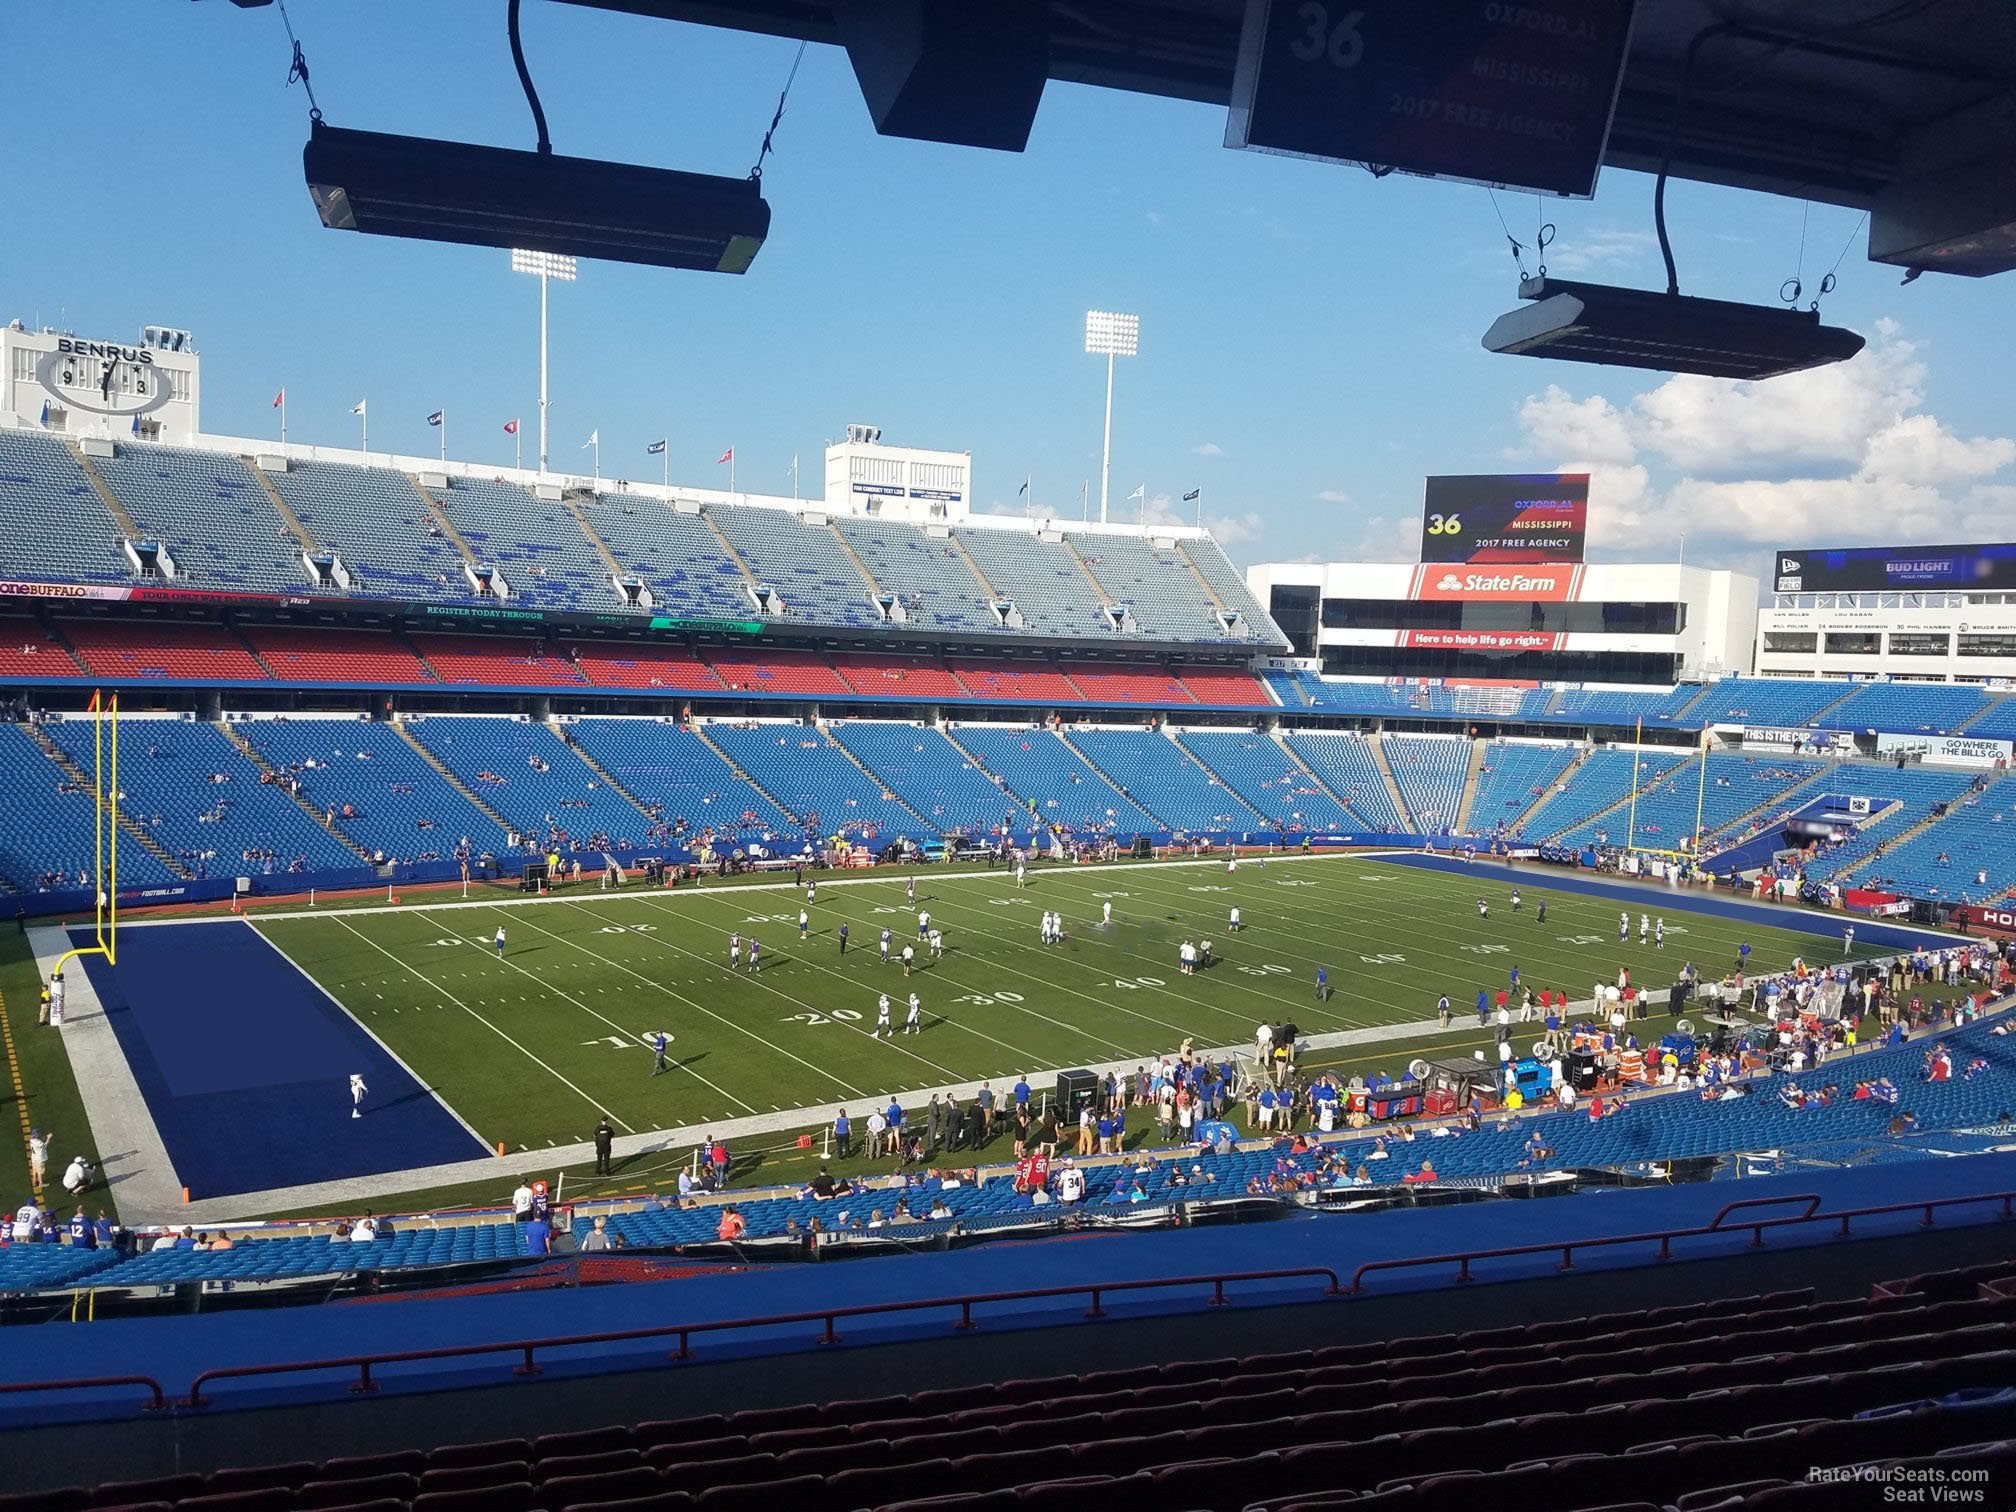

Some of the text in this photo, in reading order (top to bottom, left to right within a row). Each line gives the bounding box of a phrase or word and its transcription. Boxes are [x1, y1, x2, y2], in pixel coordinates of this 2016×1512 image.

[1290, 2, 1366, 68] 36
[1472, 55, 1590, 94] MISSISSIPPI
[1390, 93, 1577, 142] 2017 FREE AGENCY
[58, 339, 154, 363] BENRUS
[62, 370, 72, 384] 9
[136, 380, 146, 394] 3
[1427, 513, 1462, 535] 36
[1512, 520, 1572, 529] MISSISSIPPI
[1528, 540, 1571, 548] AGENCY
[1886, 561, 1951, 572] BUD LIGHT
[427, 606, 544, 619] REGISTER TODAY THROUGH
[1415, 633, 1440, 644] Here
[1442, 635, 1454, 644] to
[1455, 634, 1478, 646] help
[1480, 634, 1497, 644] life
[1498, 638, 1512, 647] go
[1745, 729, 1764, 740] THIS
[1774, 730, 1792, 742] THE
[1946, 740, 1999, 750] GO WHERE
[1941, 747, 2006, 759] THE BILLS GO.
[1886, 904, 1909, 914] BILLS
[1237, 964, 1292, 976] 50
[1114, 976, 1167, 990] 40
[962, 992, 1024, 1006] 30
[794, 1008, 864, 1026] 20
[597, 1031, 676, 1050] 10
[1356, 1096, 1364, 1106] G
[1036, 1162, 1048, 1173] 90
[1068, 1177, 1080, 1188] 34
[70, 1224, 84, 1238] 12
